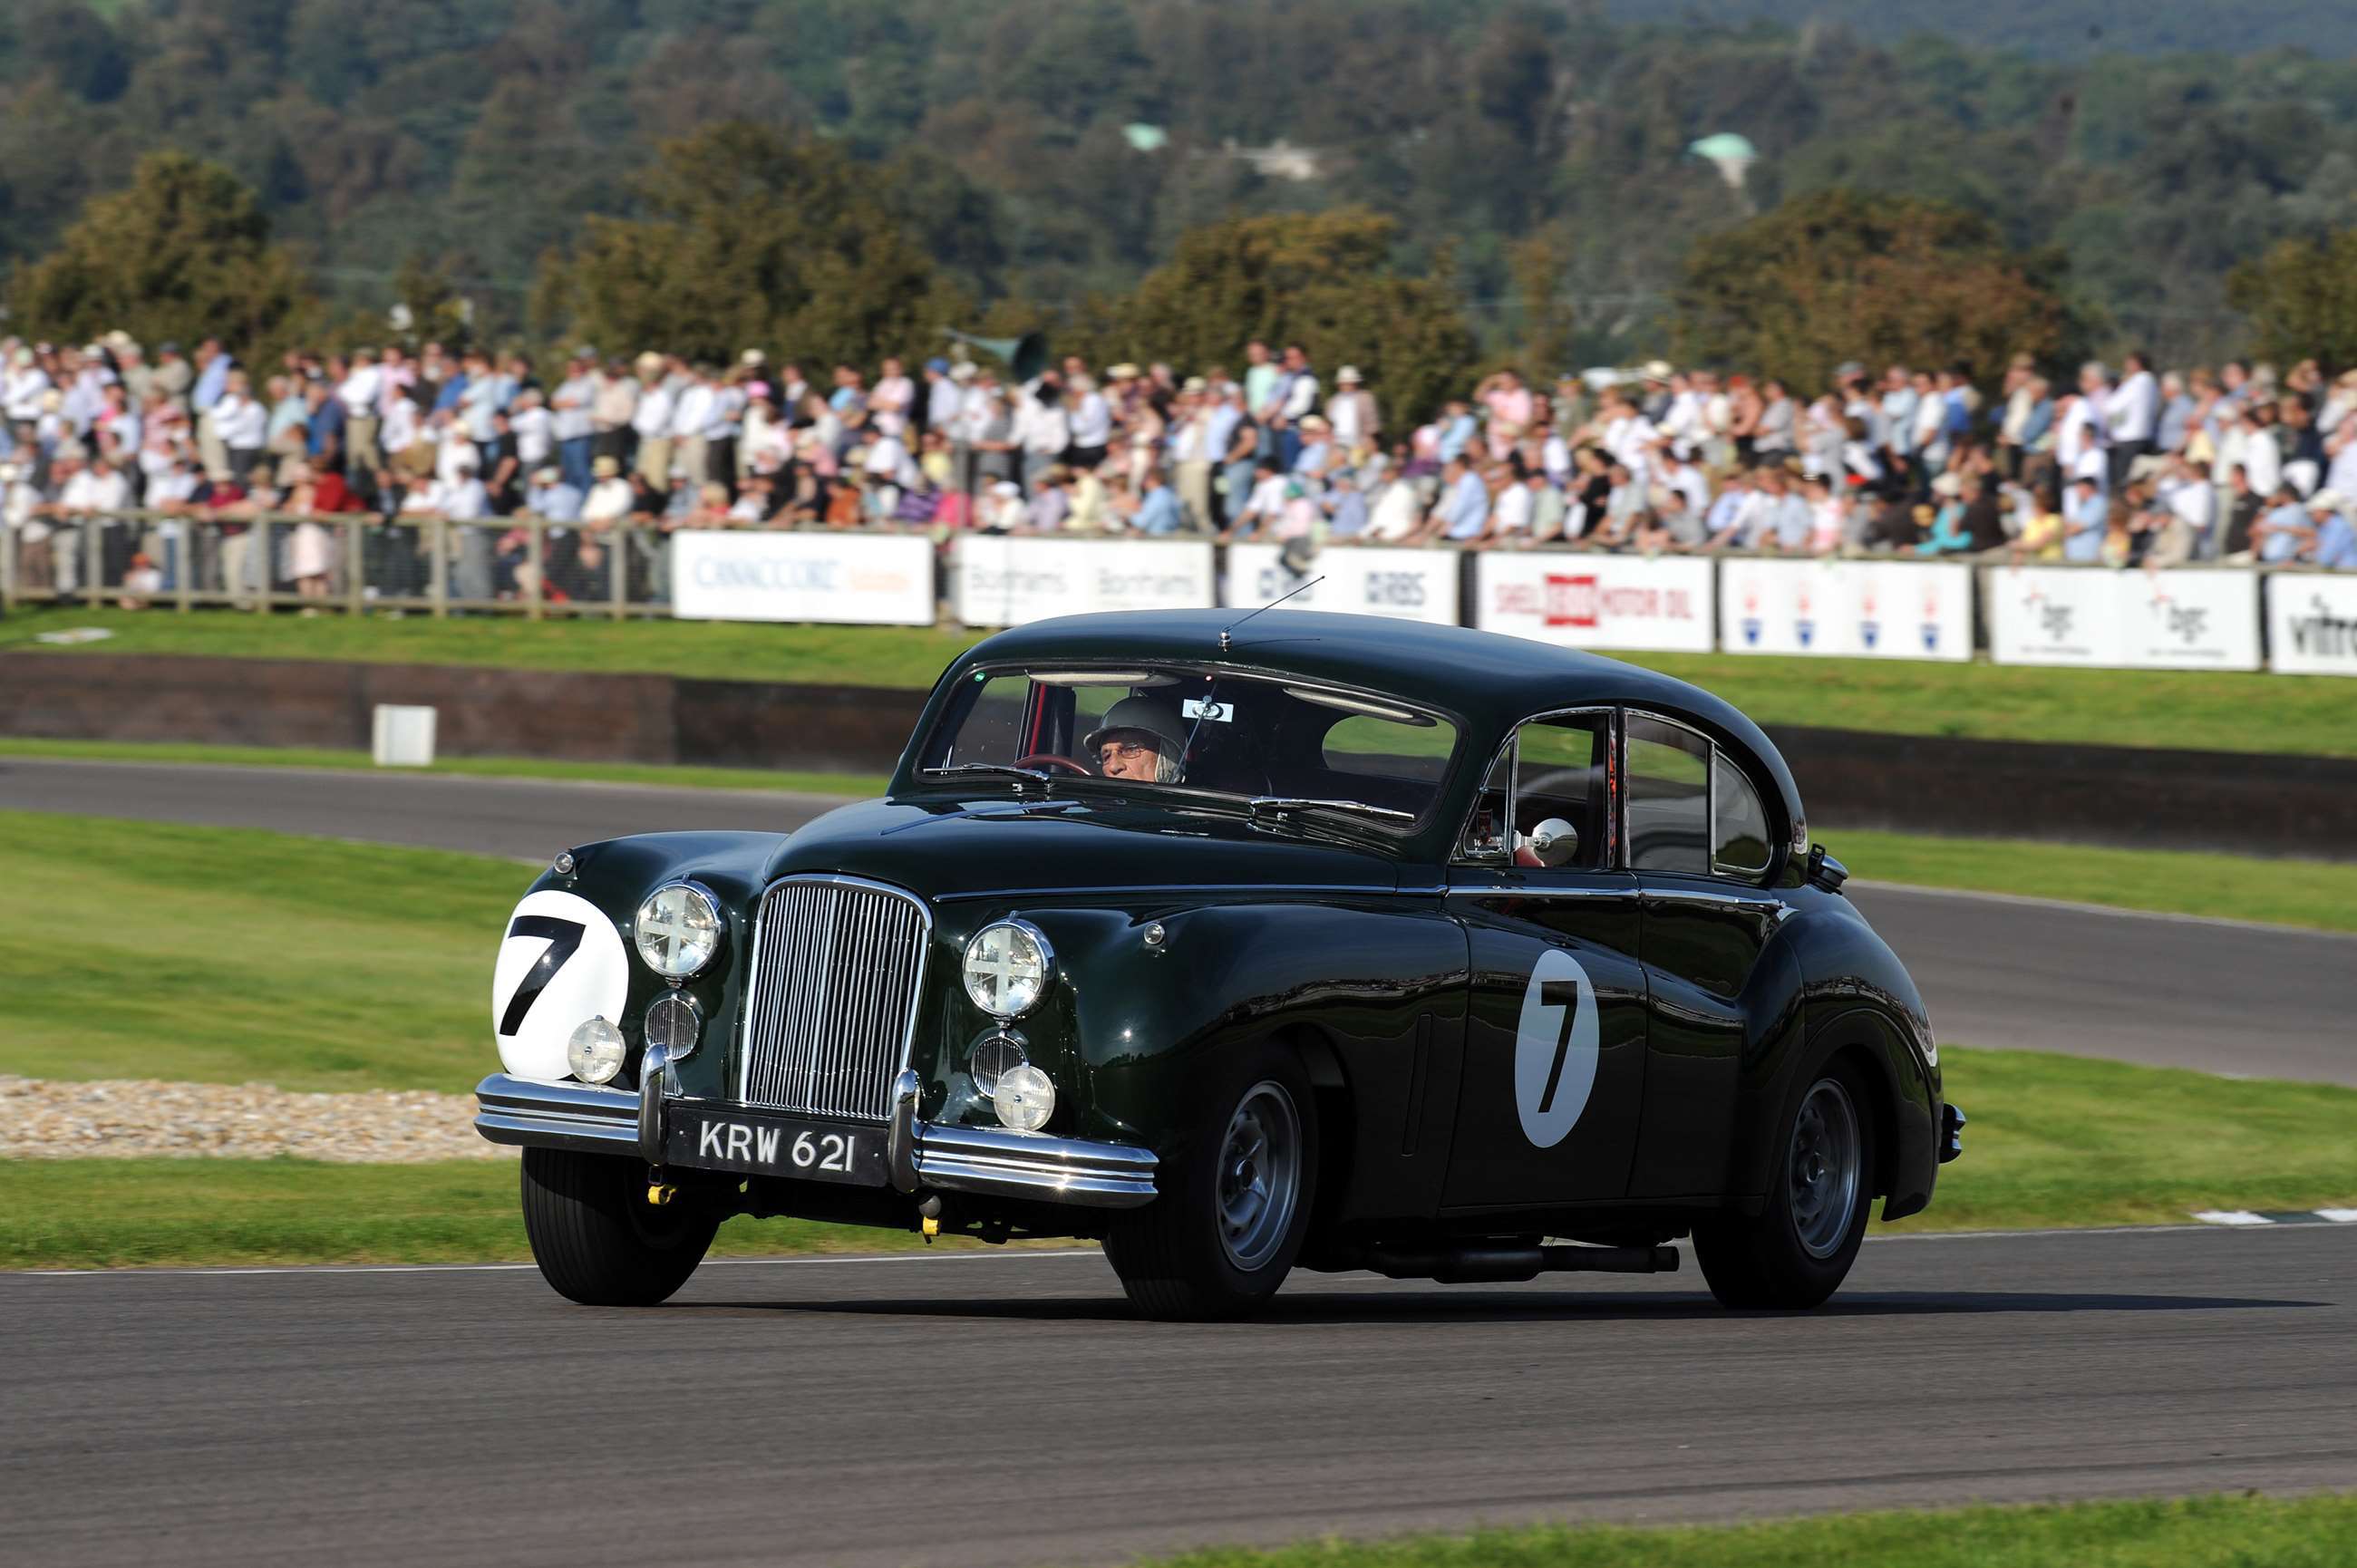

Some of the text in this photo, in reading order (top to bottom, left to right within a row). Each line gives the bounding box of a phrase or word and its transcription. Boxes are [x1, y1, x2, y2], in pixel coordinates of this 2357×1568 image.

[500, 915, 587, 1036] 7
[1537, 980, 1577, 1113] 7
[699, 1120, 855, 1172] KRW 621
